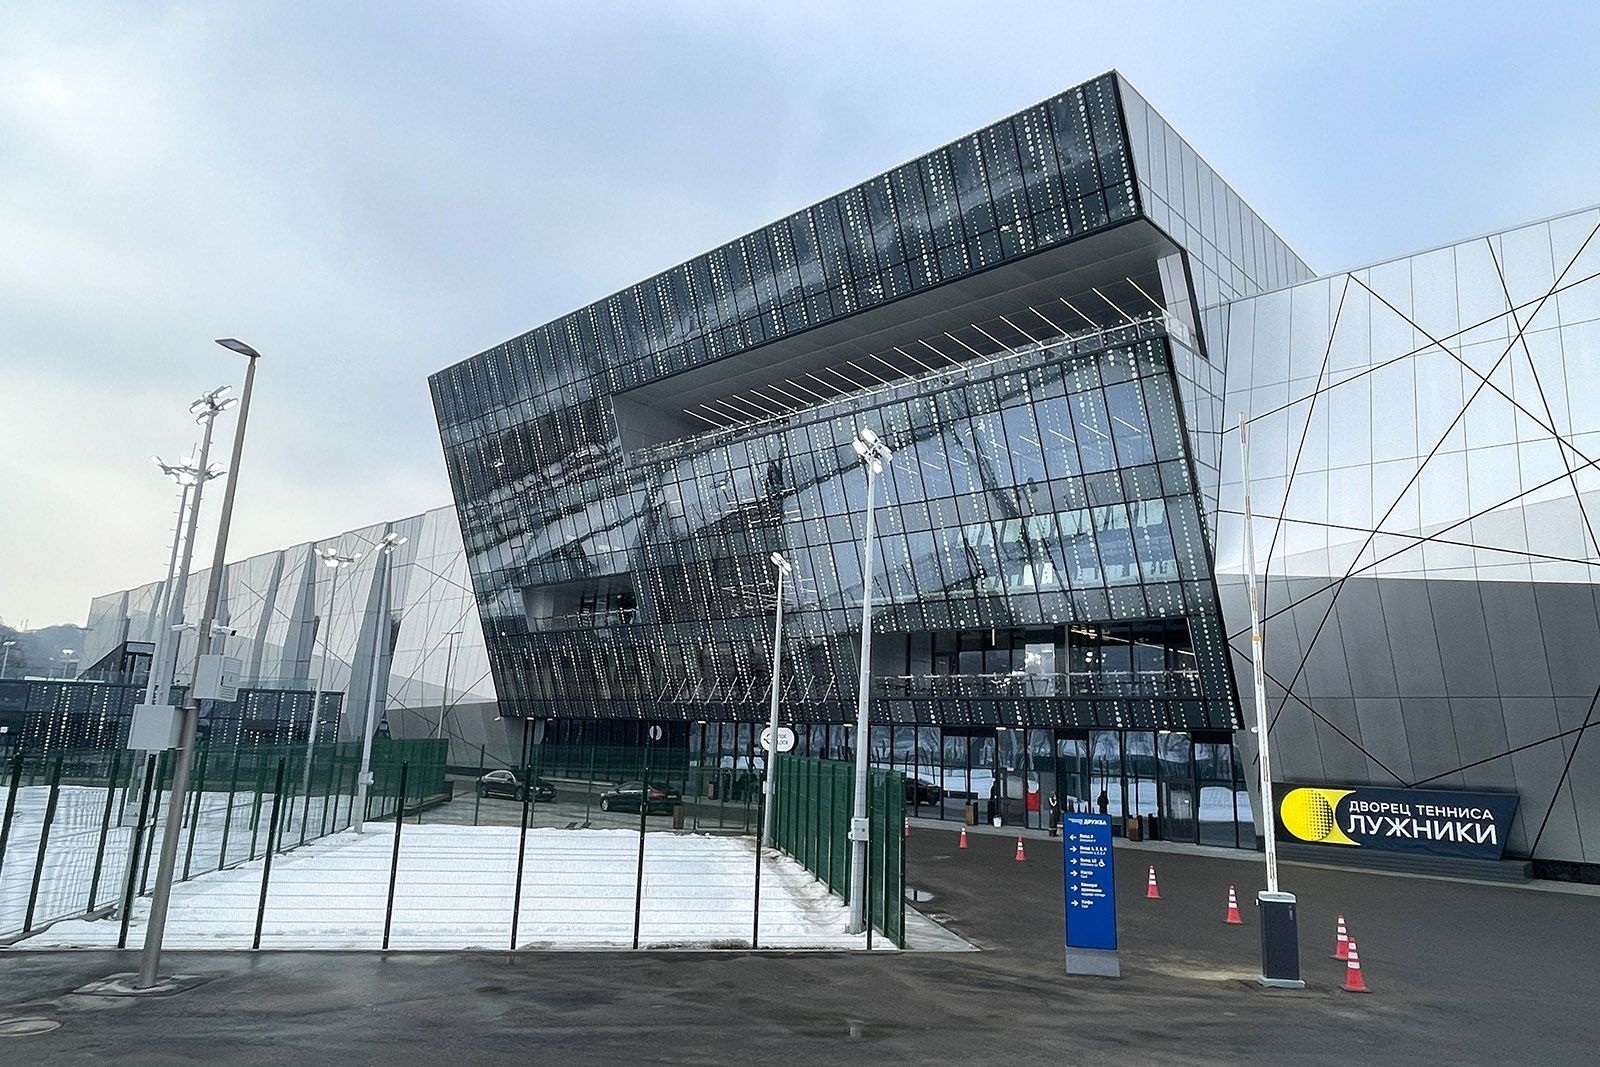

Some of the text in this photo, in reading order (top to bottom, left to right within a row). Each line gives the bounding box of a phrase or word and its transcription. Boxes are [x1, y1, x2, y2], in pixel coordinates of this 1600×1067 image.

[1349, 800, 1495, 821] ДВОРЕЦ ТЕННИСА
[1347, 814, 1499, 845] ЛУЖНИКИ
